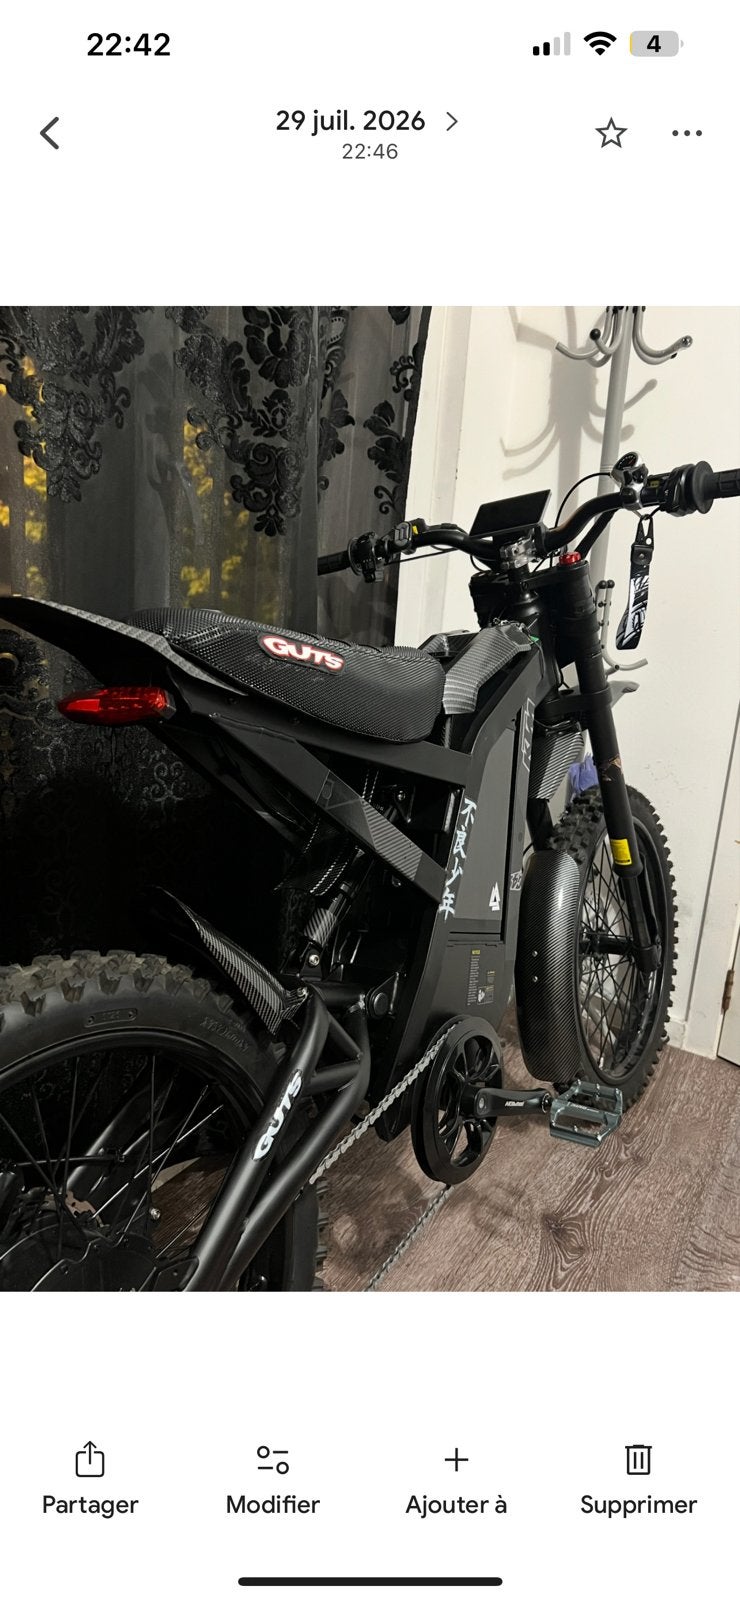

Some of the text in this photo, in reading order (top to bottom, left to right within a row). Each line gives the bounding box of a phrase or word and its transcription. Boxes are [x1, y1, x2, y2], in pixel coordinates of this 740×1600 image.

[262, 635, 345, 671] GUTS
[438, 797, 477, 921] 不良少年
[253, 1071, 302, 1160] GUTS
